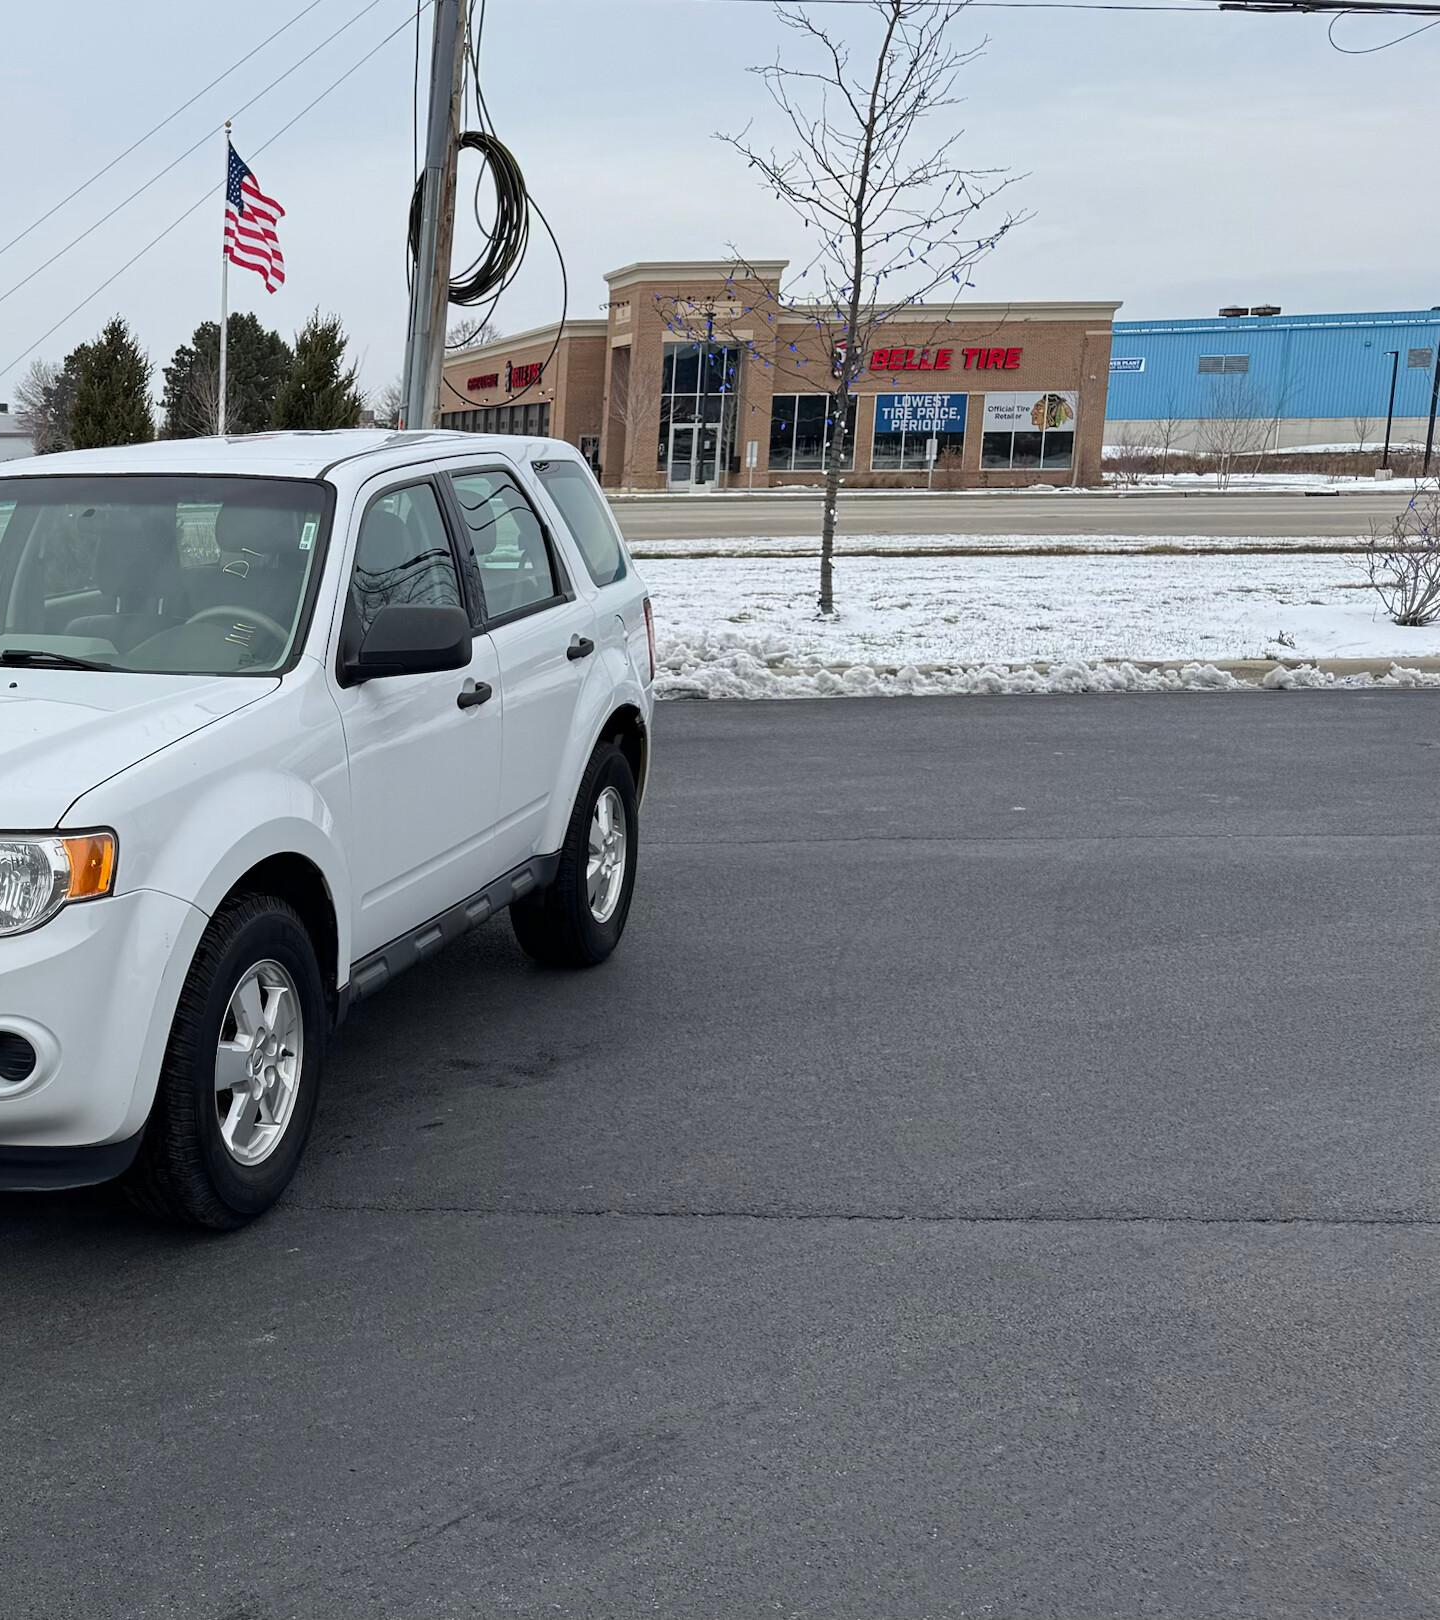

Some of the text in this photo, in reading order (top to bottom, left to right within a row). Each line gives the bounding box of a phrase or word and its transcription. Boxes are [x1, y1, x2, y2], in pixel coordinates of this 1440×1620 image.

[870, 348, 1024, 370] BELLE TIRE
[894, 396, 950, 407] LOWEST
[882, 408, 960, 420] TIRE PRICE,
[891, 420, 945, 431] PERIOD!
